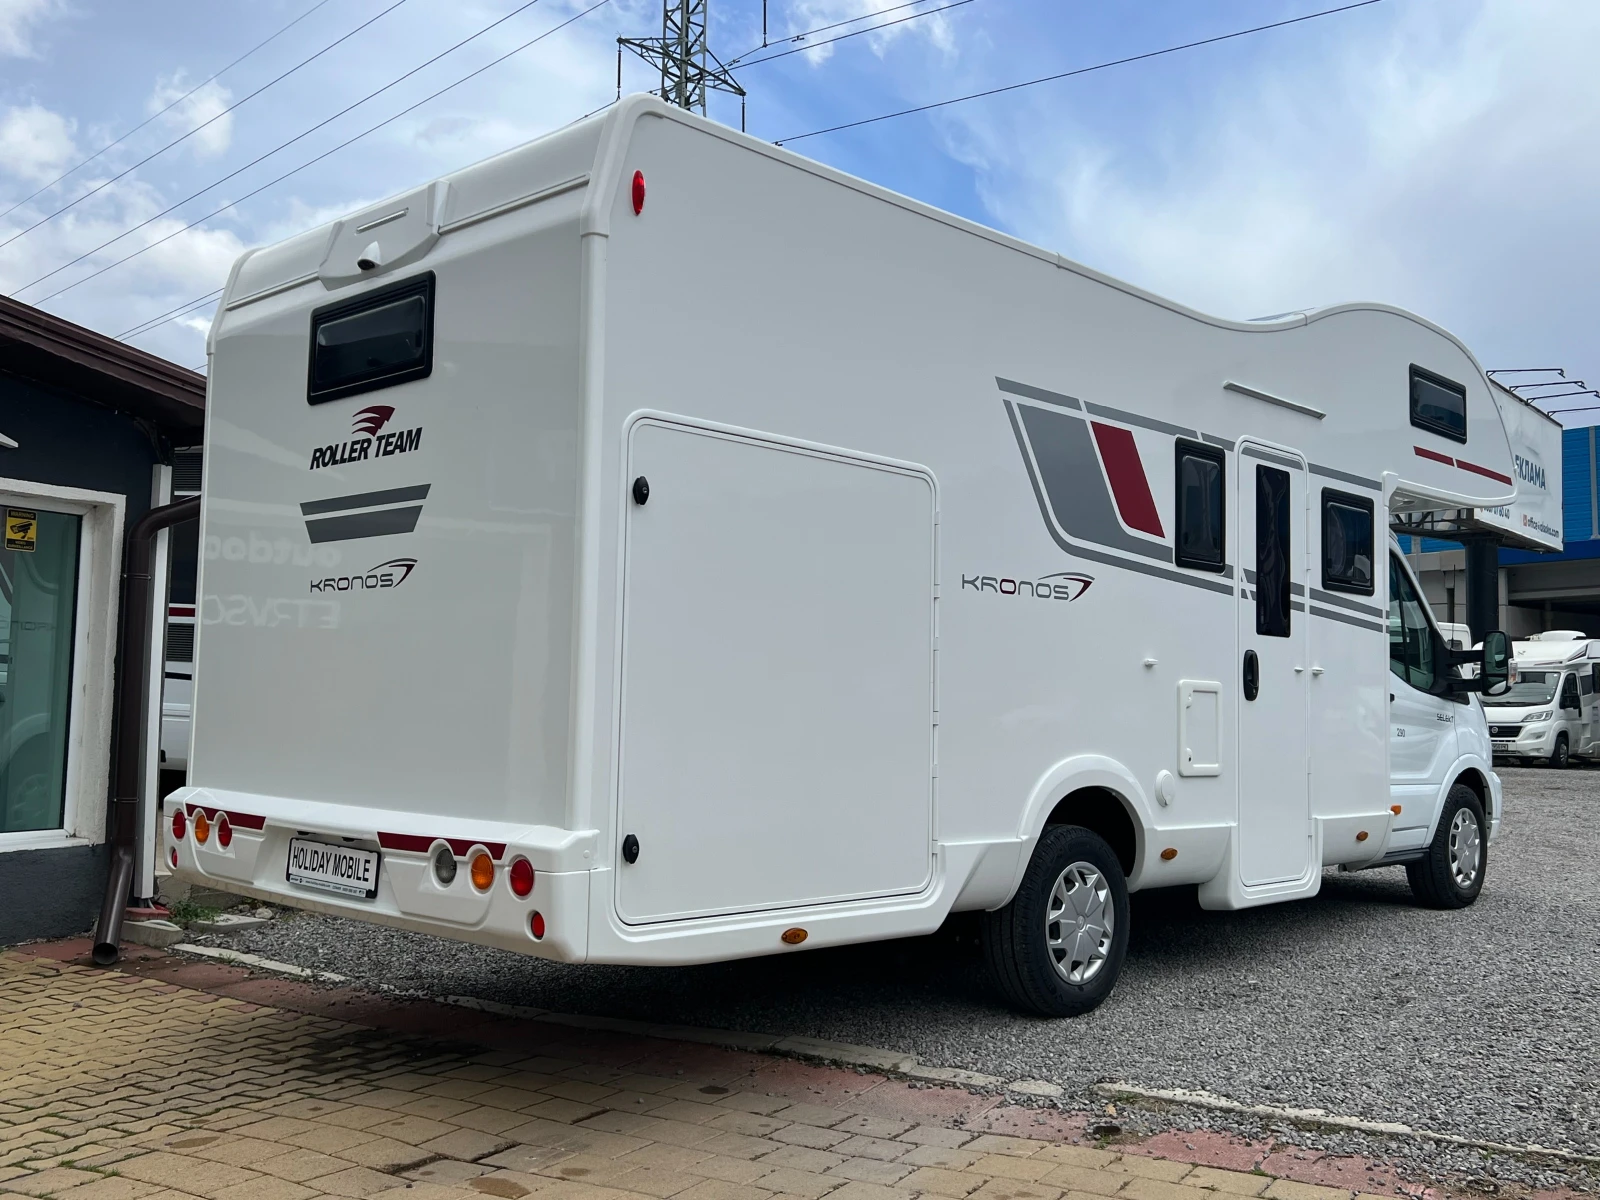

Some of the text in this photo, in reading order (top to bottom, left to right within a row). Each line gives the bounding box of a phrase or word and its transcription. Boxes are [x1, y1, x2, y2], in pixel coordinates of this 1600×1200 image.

[309, 427, 423, 470] ROLLER TEAM
[310, 573, 394, 593] KRONOS
[962, 574, 1069, 601] KRONOS
[1396, 728, 1406, 737] 290
[292, 846, 371, 883] HOLIDAY MOBILE
